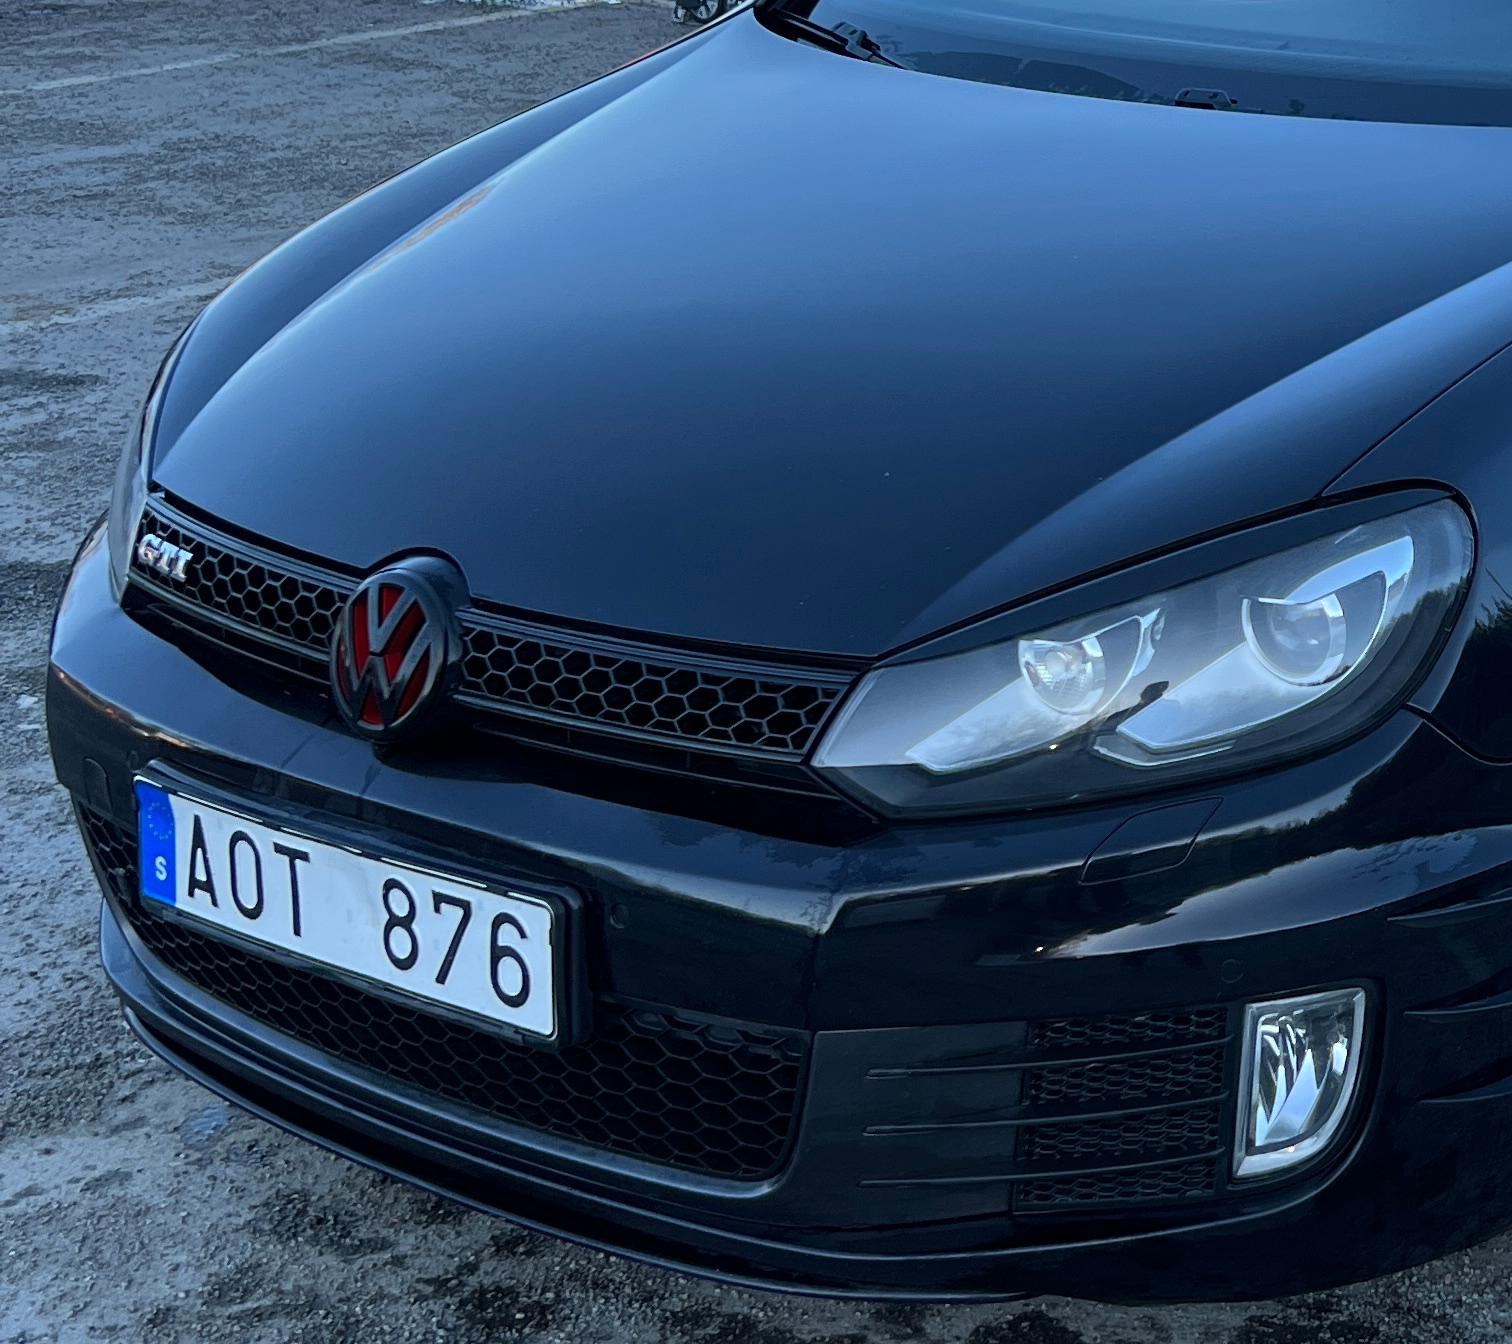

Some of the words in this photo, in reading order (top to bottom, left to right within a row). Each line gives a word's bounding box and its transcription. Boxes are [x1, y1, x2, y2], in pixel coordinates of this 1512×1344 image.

[138, 533, 193, 582] GTI
[154, 858, 168, 882] S
[187, 813, 311, 939] AOT
[382, 876, 531, 1009] 876
